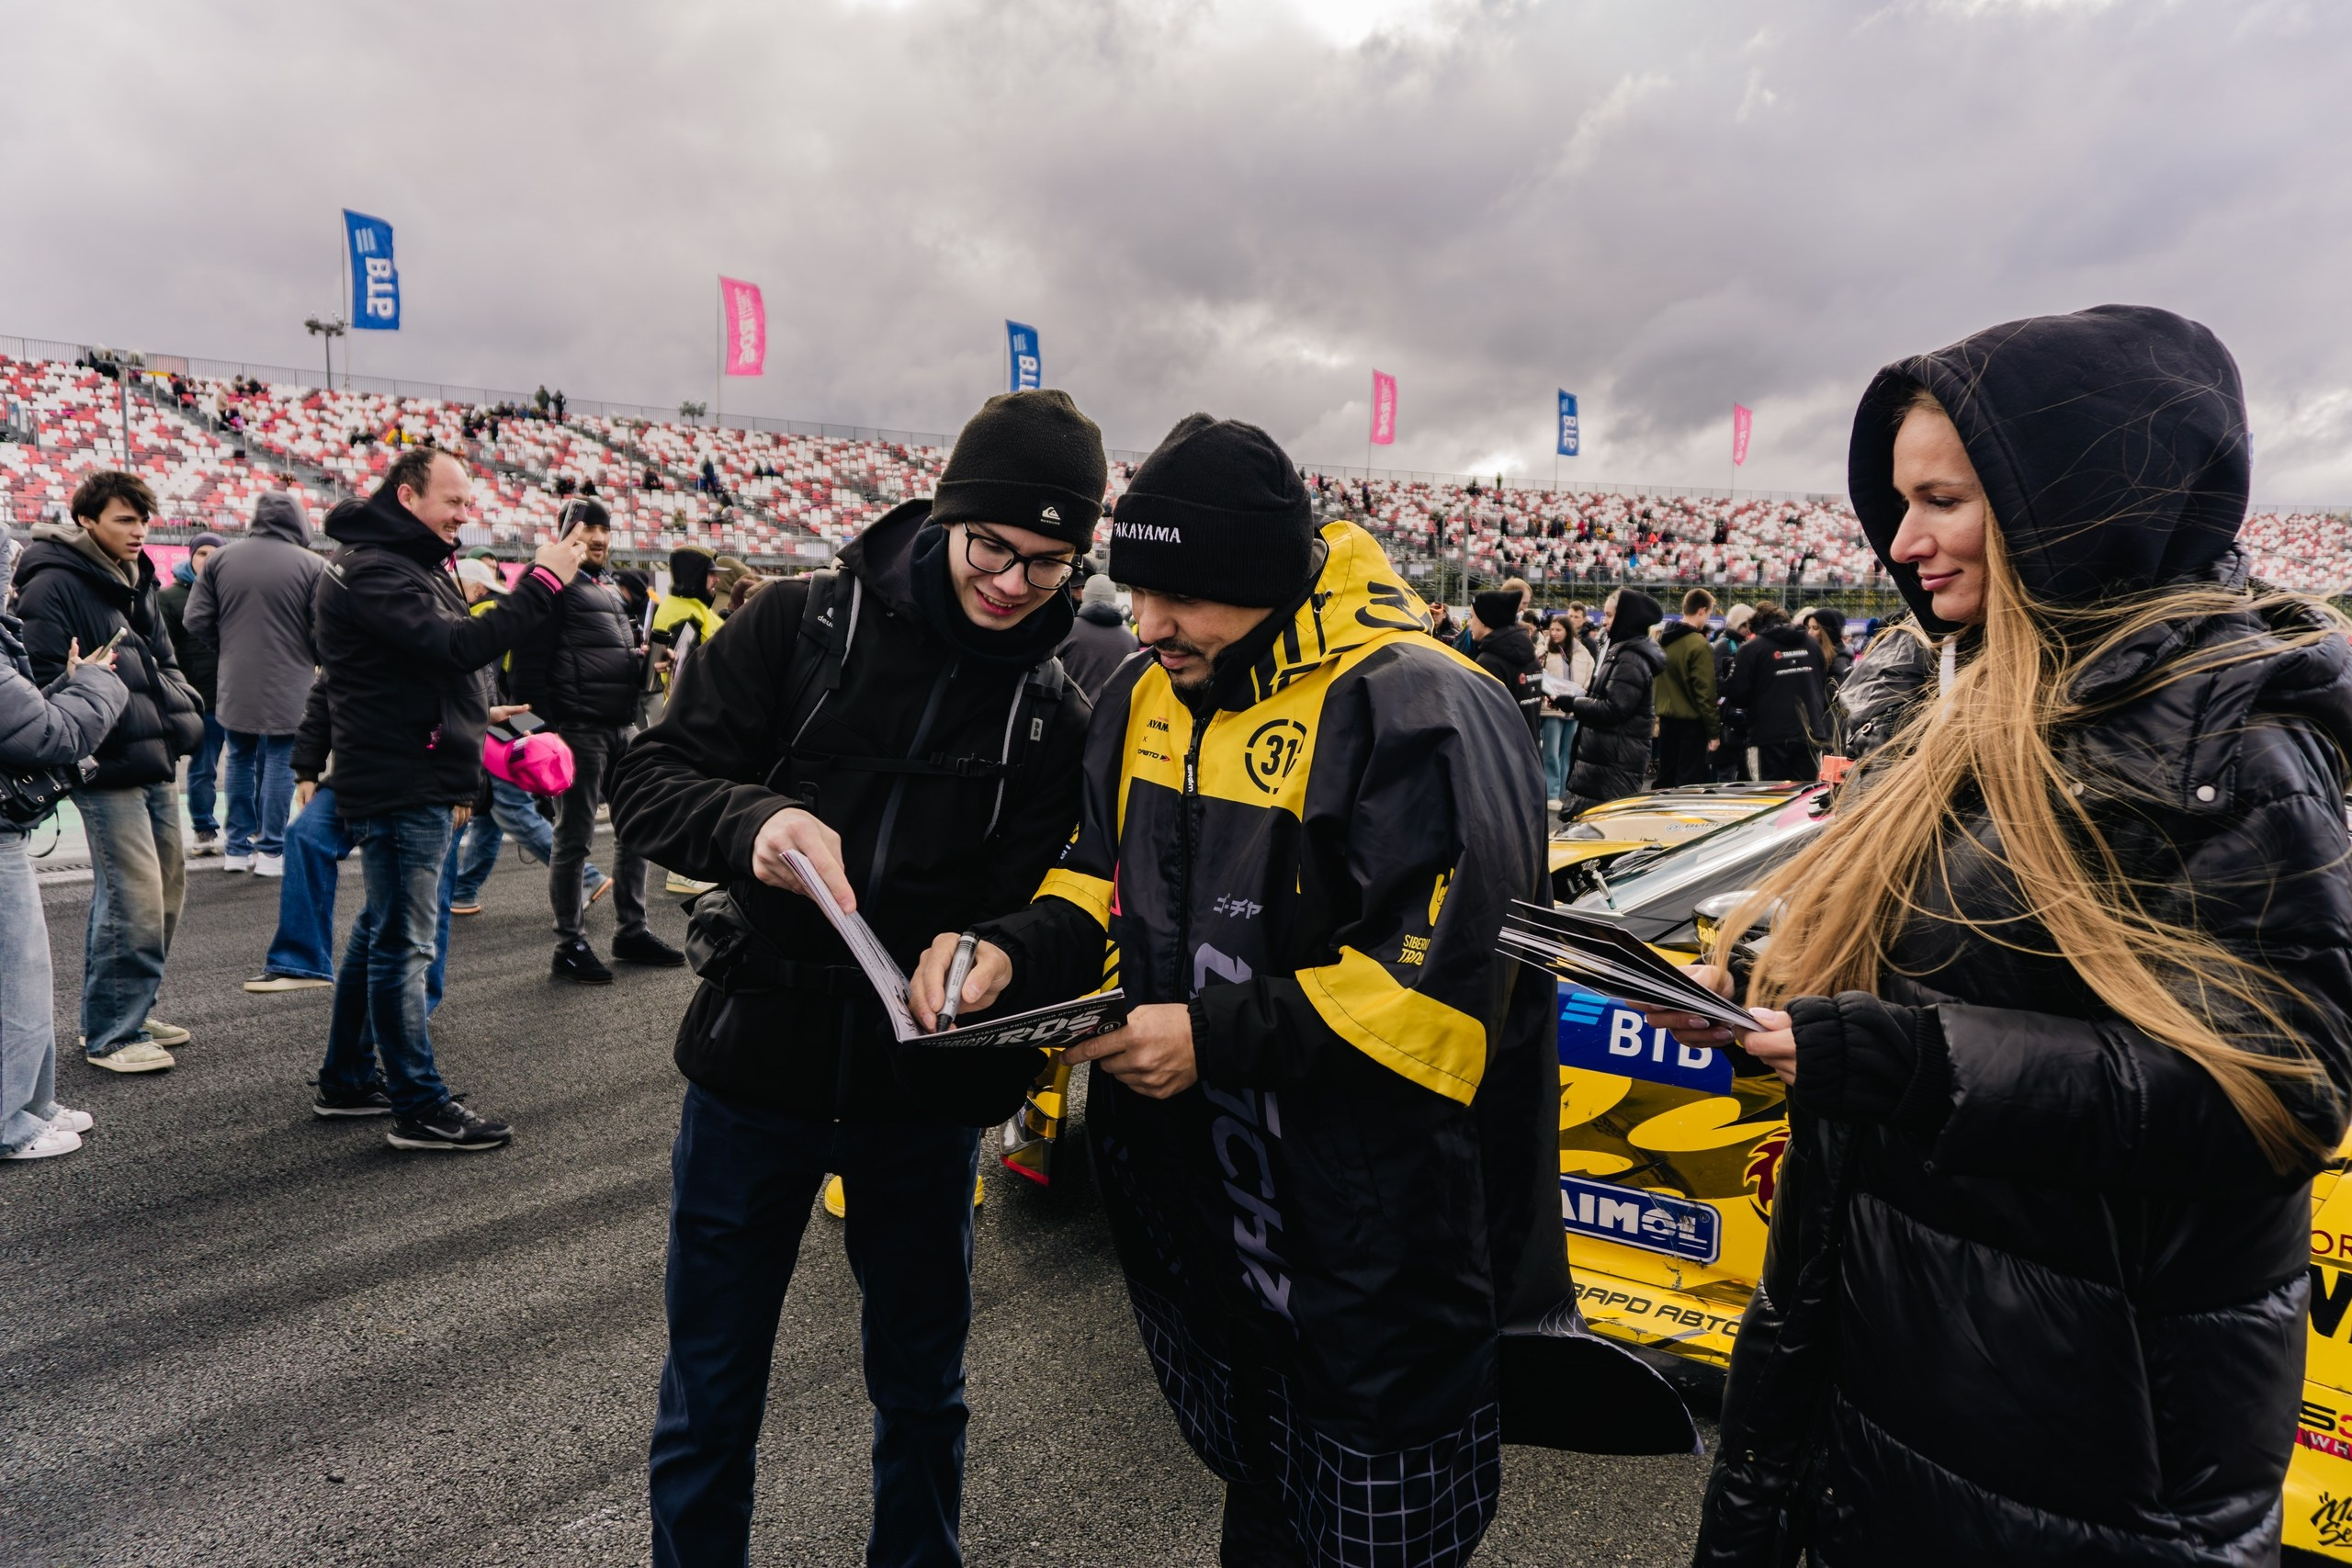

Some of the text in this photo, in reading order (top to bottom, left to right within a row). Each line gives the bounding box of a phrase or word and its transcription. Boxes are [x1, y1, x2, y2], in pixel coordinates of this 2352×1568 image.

[1114, 522, 1182, 544] TAKAYAMA
[1261, 734, 1299, 778] 31
[993, 1008, 1109, 1045] RDS
